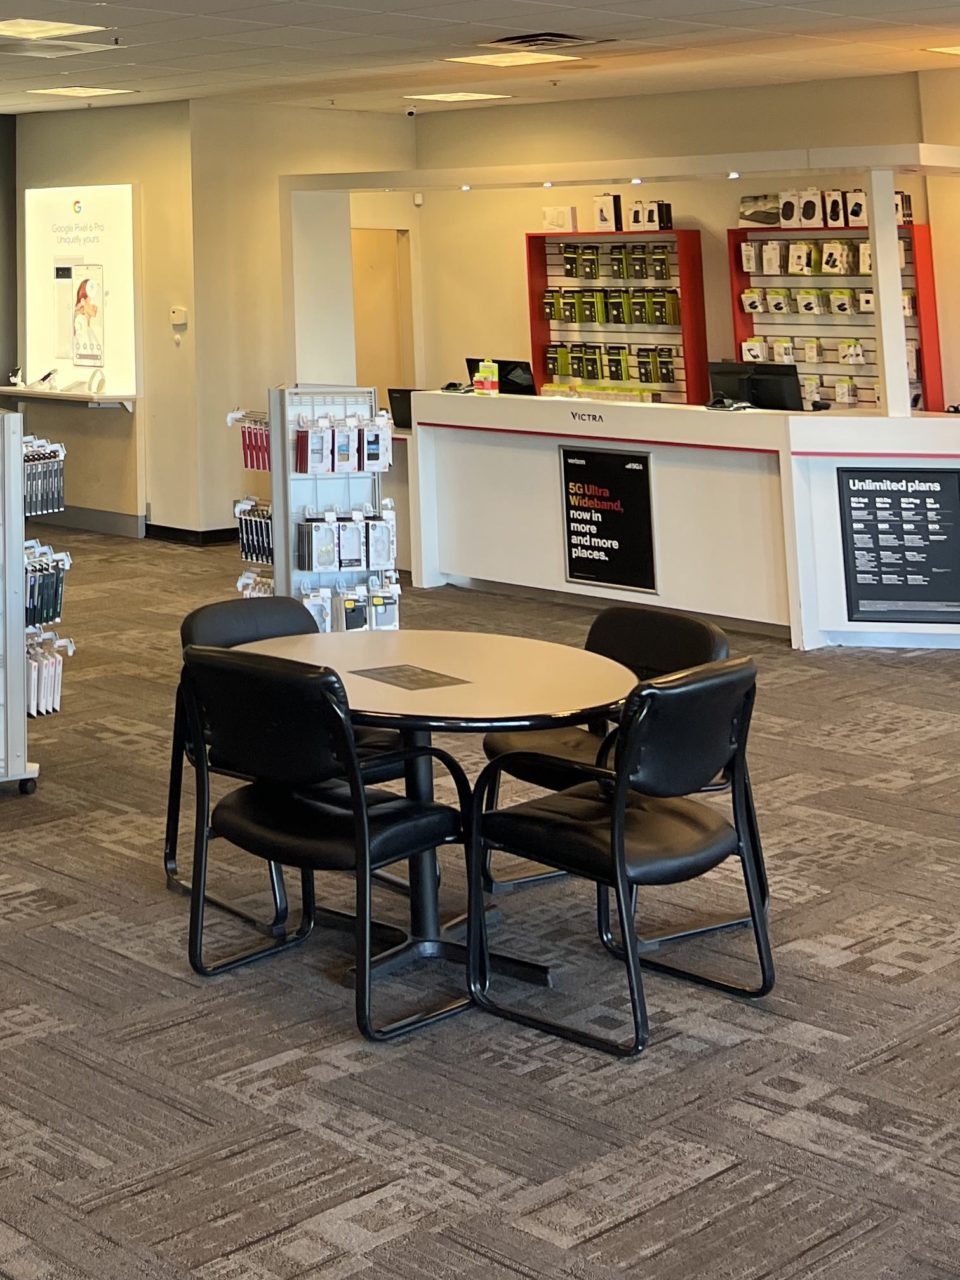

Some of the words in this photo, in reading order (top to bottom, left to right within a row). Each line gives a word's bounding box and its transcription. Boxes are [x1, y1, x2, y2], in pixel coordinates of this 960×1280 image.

[570, 411, 604, 423] VICTRA
[568, 482, 583, 494] 5G
[584, 484, 610, 497] Ultra
[848, 479, 907, 491] Unlimited
[907, 480, 941, 493] plans
[569, 495, 624, 513] Wideband,
[570, 510, 591, 520] now
[591, 509, 602, 522] in
[570, 522, 597, 534] more
[571, 534, 590, 546] and
[591, 537, 619, 549] more
[572, 547, 609, 561] places.
